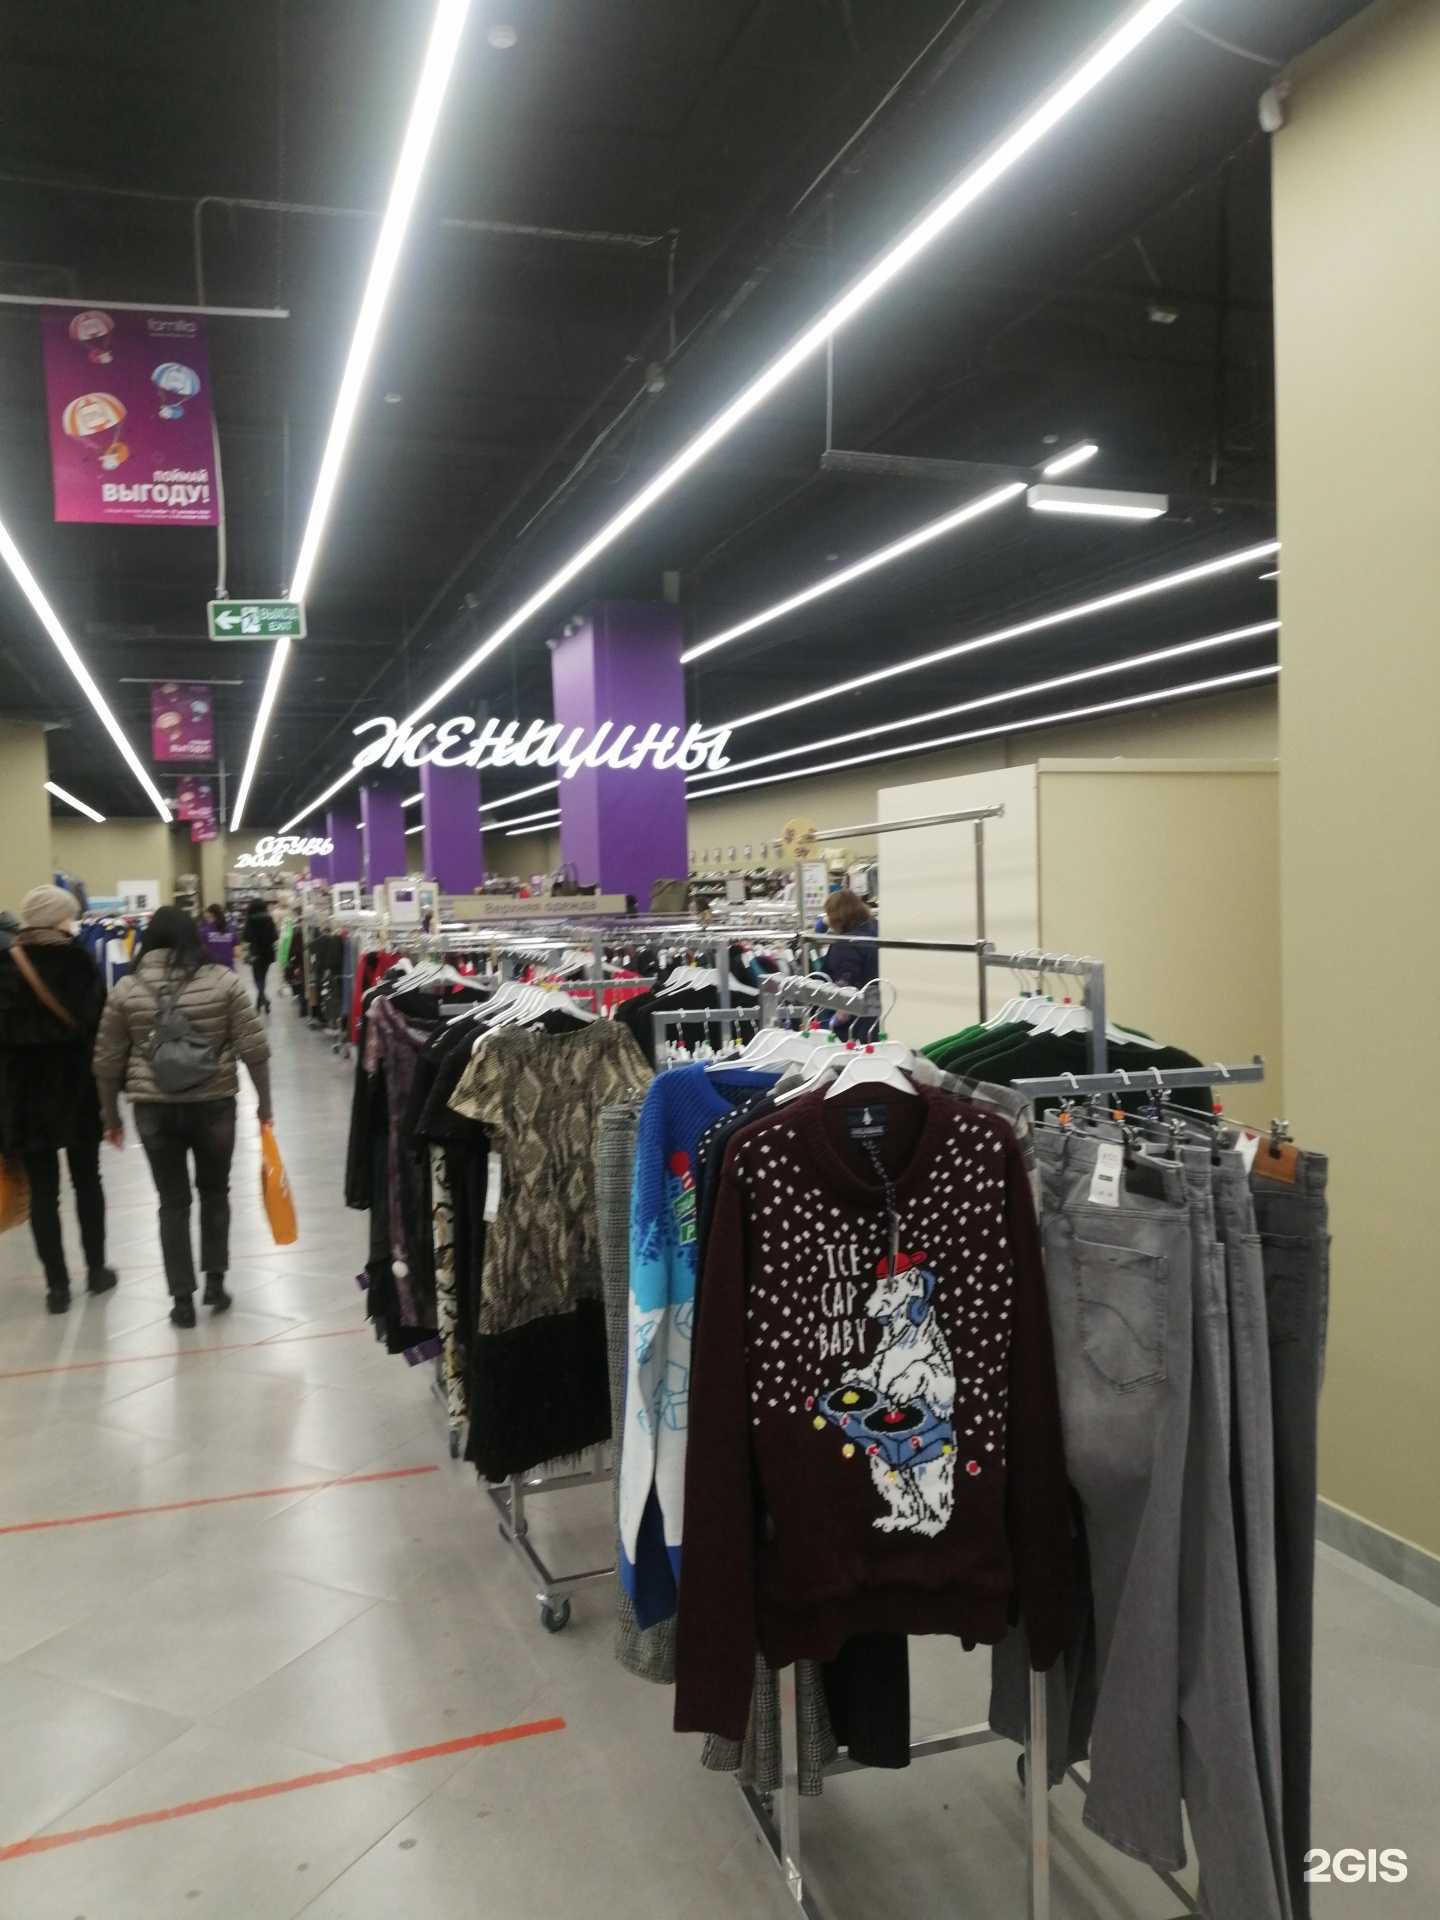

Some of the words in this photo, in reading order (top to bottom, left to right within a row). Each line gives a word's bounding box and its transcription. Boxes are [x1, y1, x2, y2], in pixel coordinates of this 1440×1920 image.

[101, 483, 211, 507] ВЫГОДУ!
[823, 1243, 861, 1279] ICE
[820, 1281, 858, 1318] CAP
[819, 1318, 867, 1361] BABY
